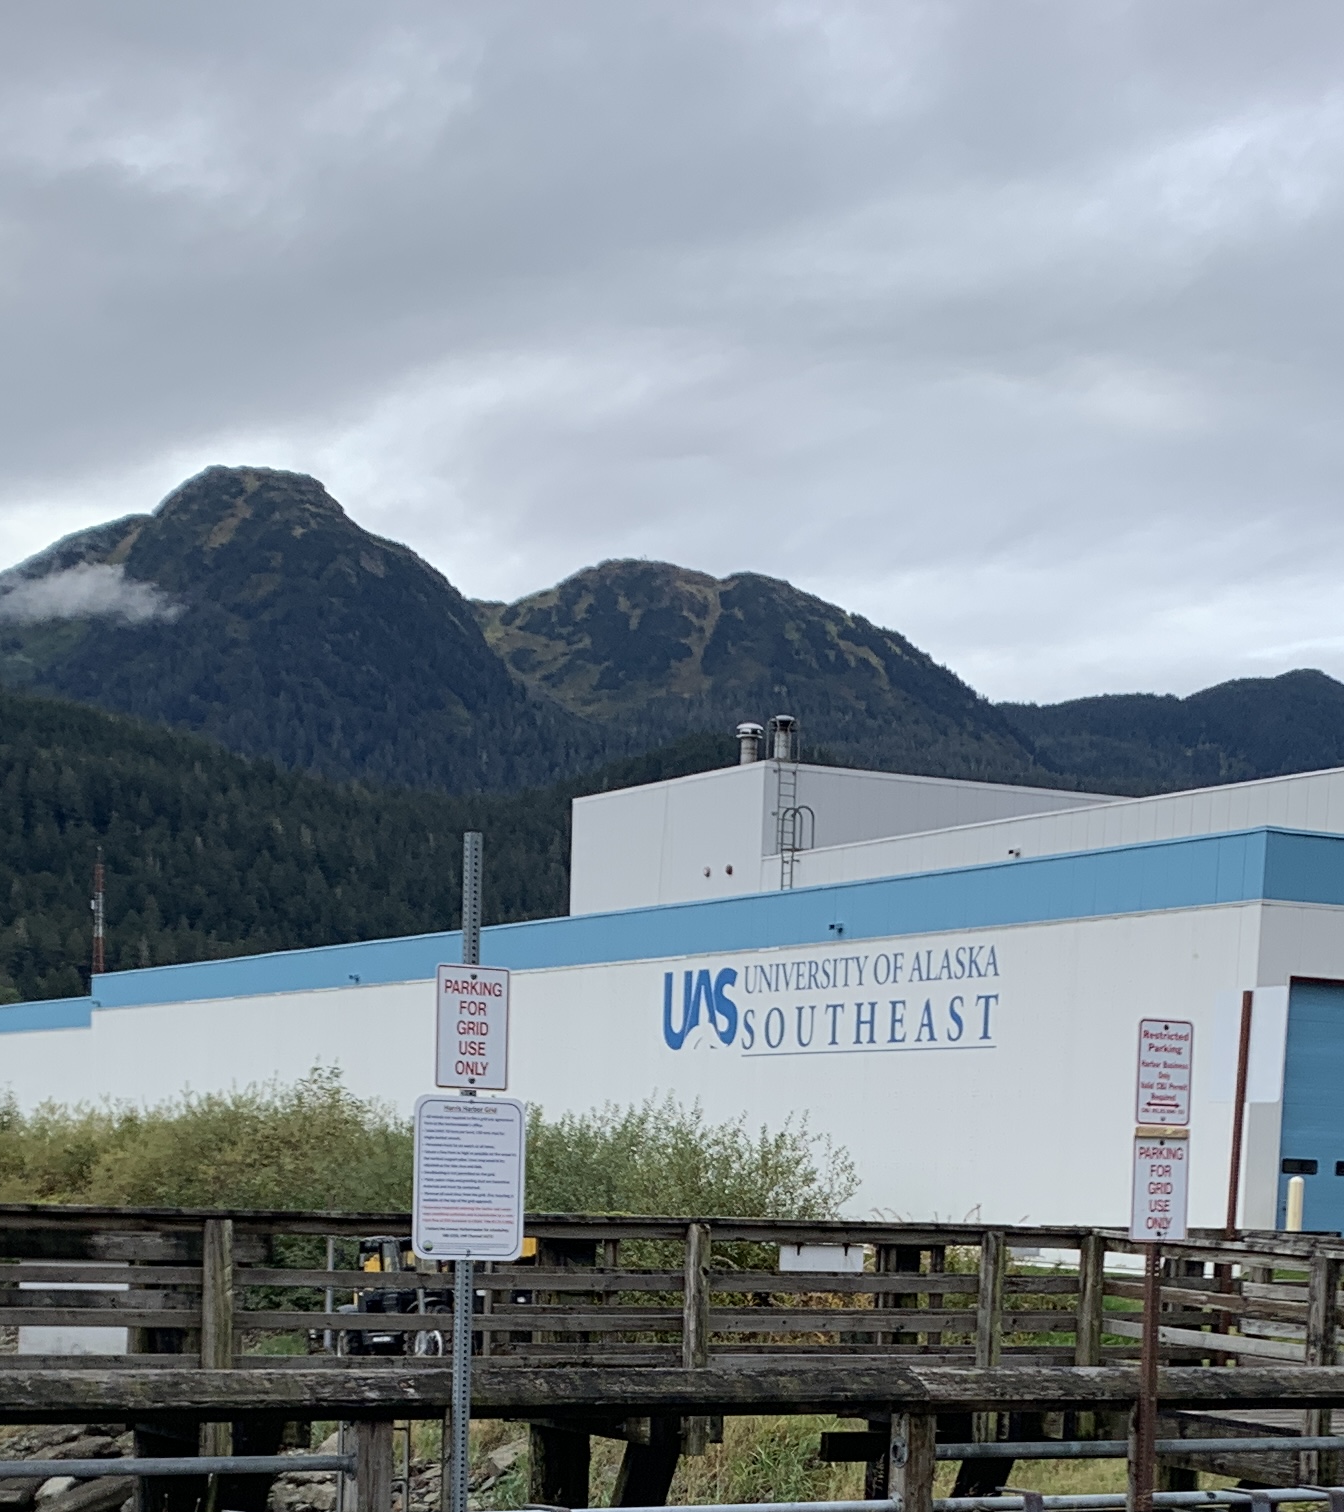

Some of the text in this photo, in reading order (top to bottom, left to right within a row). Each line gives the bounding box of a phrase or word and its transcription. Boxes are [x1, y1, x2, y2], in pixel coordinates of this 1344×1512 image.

[744, 945, 1000, 994] UNIVERSITY OF ALASKA
[444, 979, 503, 997] PARKING
[459, 1000, 487, 1016] FOR
[664, 968, 738, 1050] UAS
[456, 1020, 489, 1036] GRID
[741, 994, 999, 1050] SOUTHEAST
[1143, 1030, 1189, 1041] Restricted
[459, 1041, 486, 1056] USE
[1148, 1043, 1183, 1055] Parking
[455, 1060, 489, 1076] ONLY
[1139, 1147, 1183, 1160] PARKING
[1150, 1165, 1171, 1177] FOR
[1148, 1182, 1173, 1194] GRID
[1149, 1200, 1170, 1212] USE
[1147, 1217, 1172, 1229] ONLY
